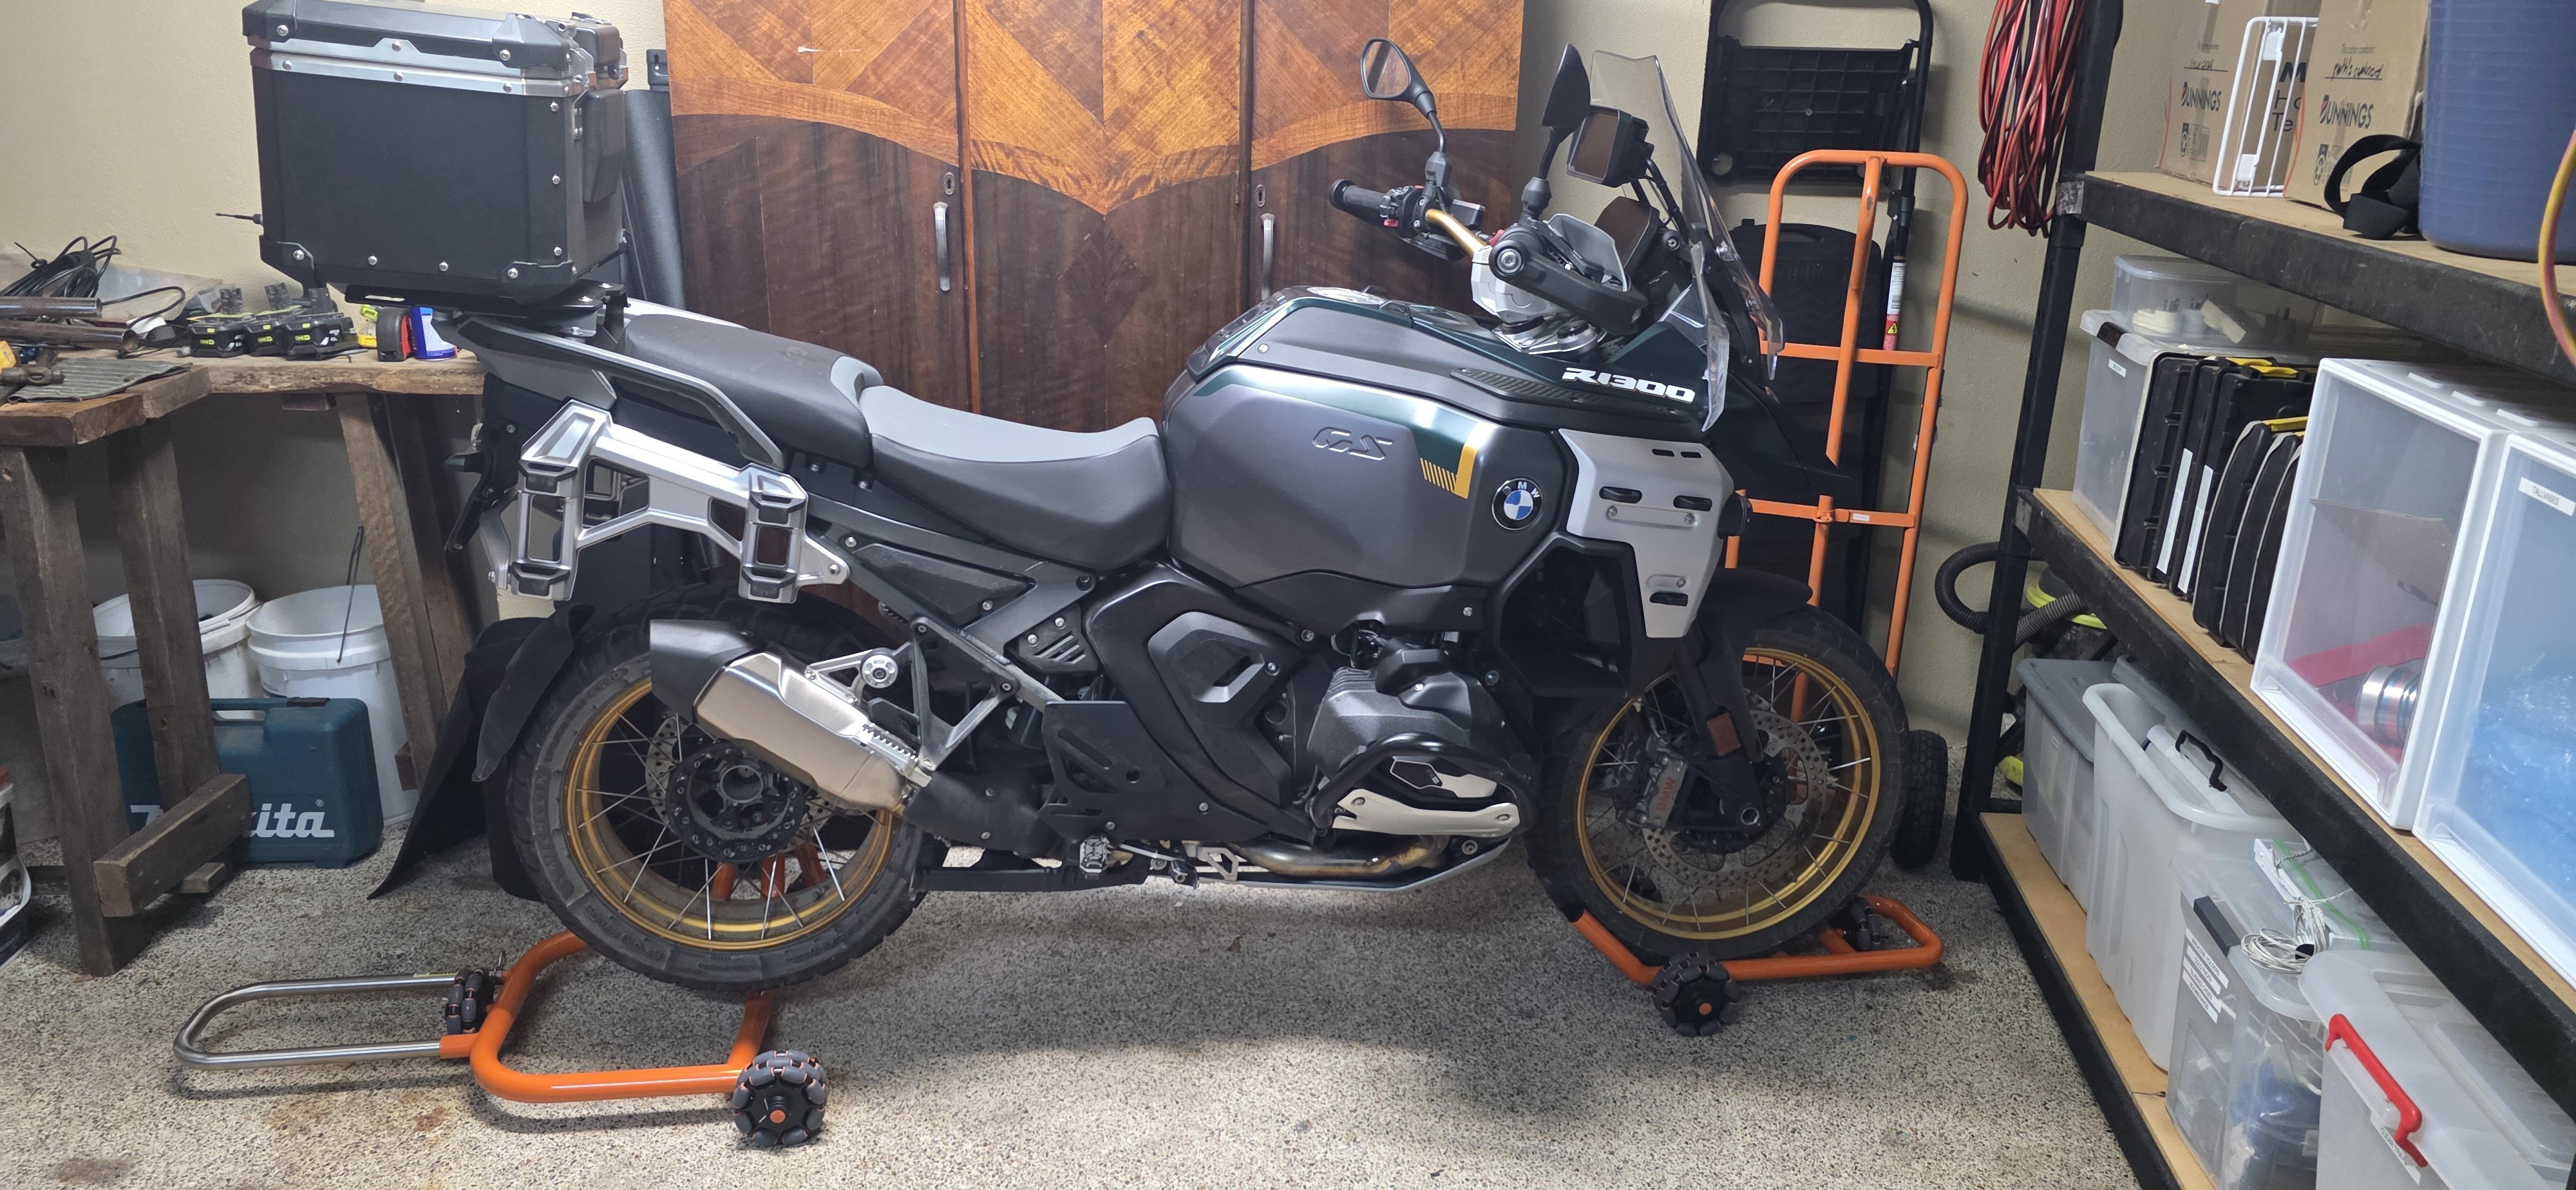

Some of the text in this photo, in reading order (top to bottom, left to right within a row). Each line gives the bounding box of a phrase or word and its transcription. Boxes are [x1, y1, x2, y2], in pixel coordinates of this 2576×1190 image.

[2182, 81, 2222, 112] BUNNINGS
[2320, 95, 2373, 129] BUNNINGS
[1562, 367, 1696, 404] R1300
[1312, 426, 1394, 461] GS
[1501, 481, 1540, 498] BMW
[1656, 777, 1676, 811] BMW
